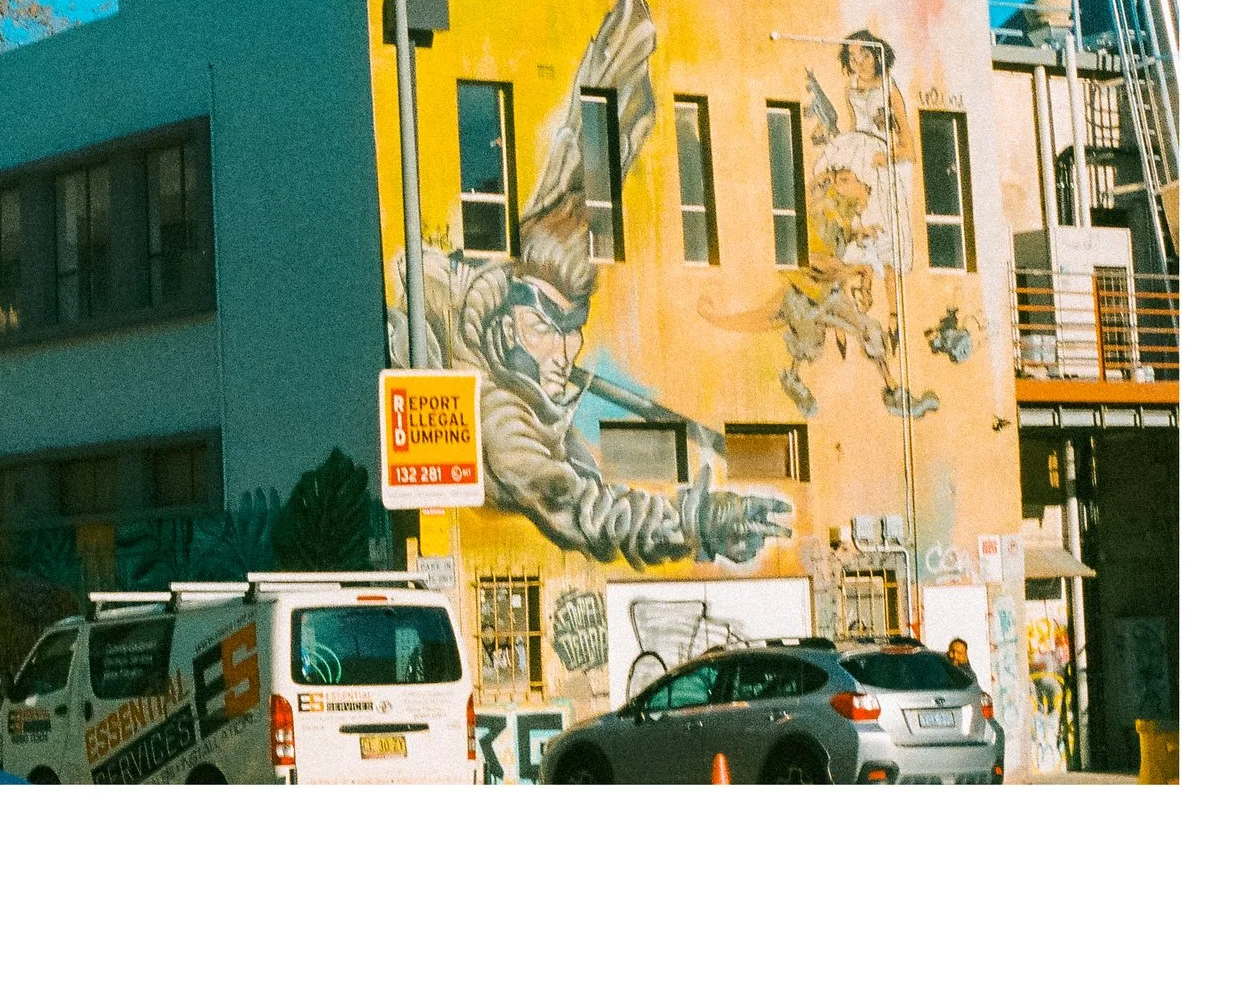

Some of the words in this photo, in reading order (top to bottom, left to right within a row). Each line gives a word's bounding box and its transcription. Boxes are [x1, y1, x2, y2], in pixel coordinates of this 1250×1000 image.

[395, 467, 417, 483] 132
[421, 466, 442, 482] 281
[193, 622, 261, 739] ES
[298, 693, 325, 713] ES
[325, 692, 372, 701] ESSENTIAL
[327, 702, 374, 713] SERVICES
[85, 668, 190, 766] ESSENTIAL
